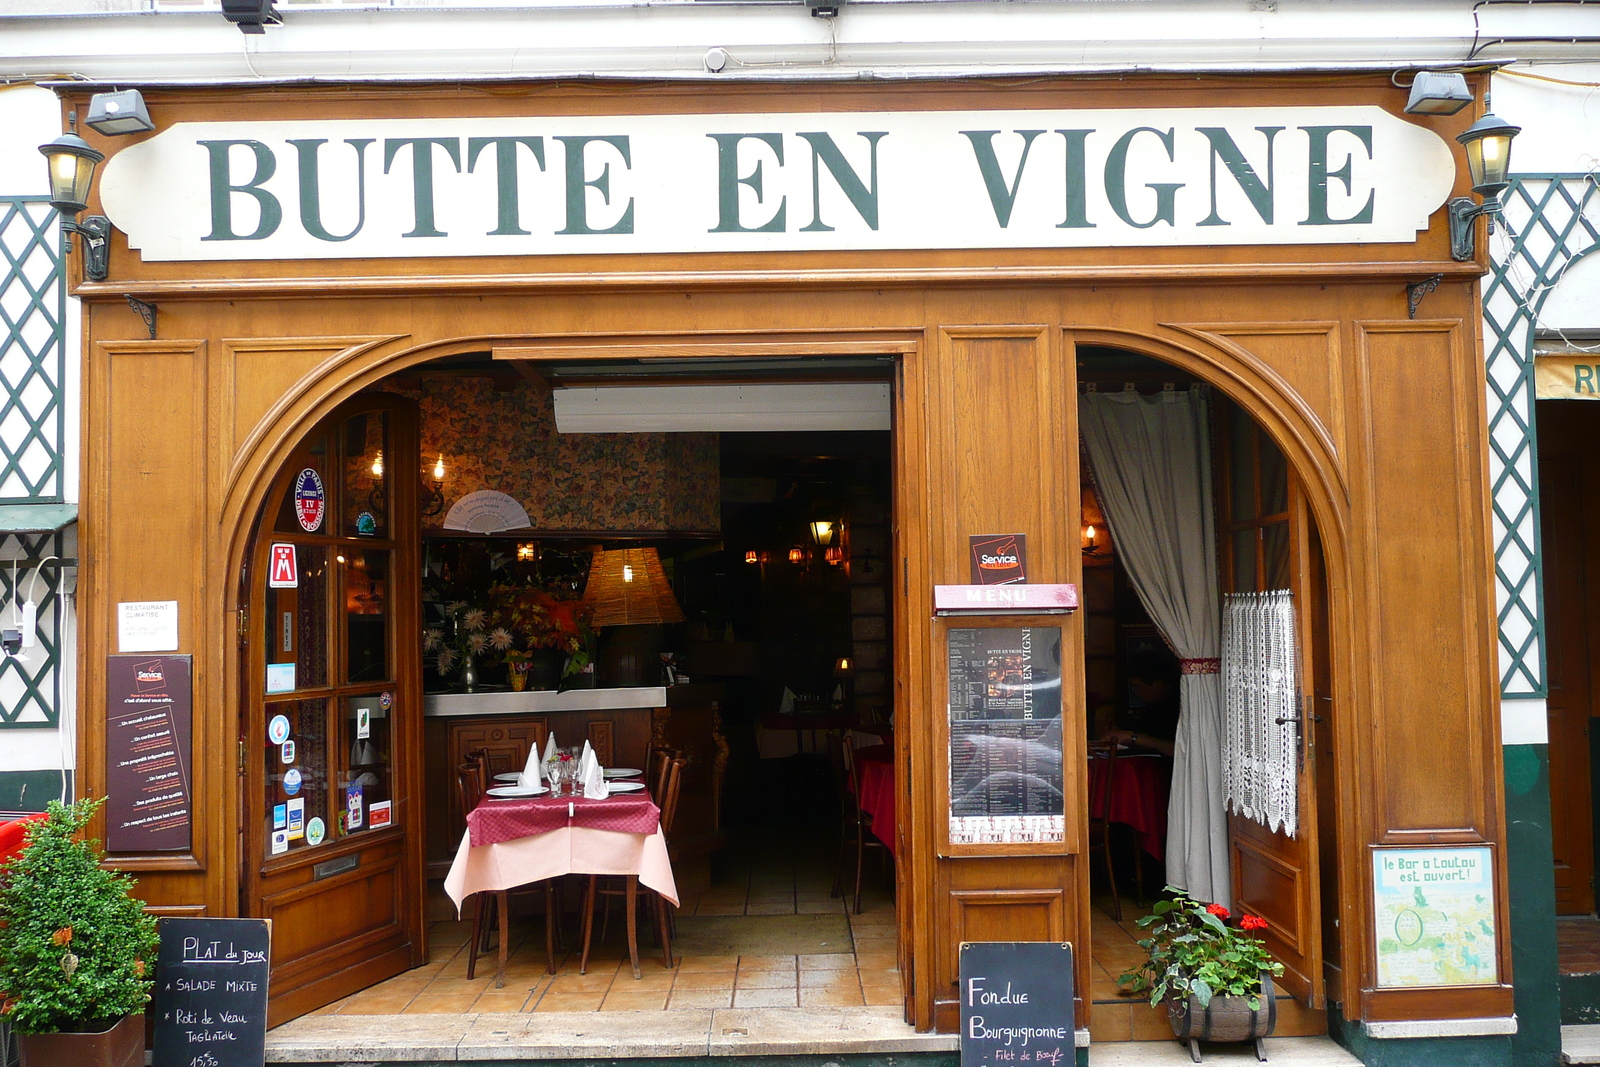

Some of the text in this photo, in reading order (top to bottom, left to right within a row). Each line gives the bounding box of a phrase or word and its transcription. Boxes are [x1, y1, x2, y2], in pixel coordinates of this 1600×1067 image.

[197, 125, 1375, 242] BUTTE EN VIGNE
[1574, 364, 1600, 393] R
[297, 473, 306, 493] VILLE
[312, 473, 322, 494] PARIS
[306, 500, 314, 508] IV
[982, 553, 1016, 564] Service
[966, 589, 1027, 602] MENU
[1023, 665, 1032, 680] EN
[1023, 683, 1032, 720] BUTTE
[145, 796, 162, 804] produits
[1384, 856, 1475, 870] le Bar à toutou
[1400, 870, 1420, 882] est
[184, 937, 266, 965] PLAT du JOUR
[177, 978, 216, 991] SALADE
[176, 1009, 247, 1024] Roti de Veau
[995, 1050, 1015, 1061] Filet
[1020, 1050, 1030, 1060] de
